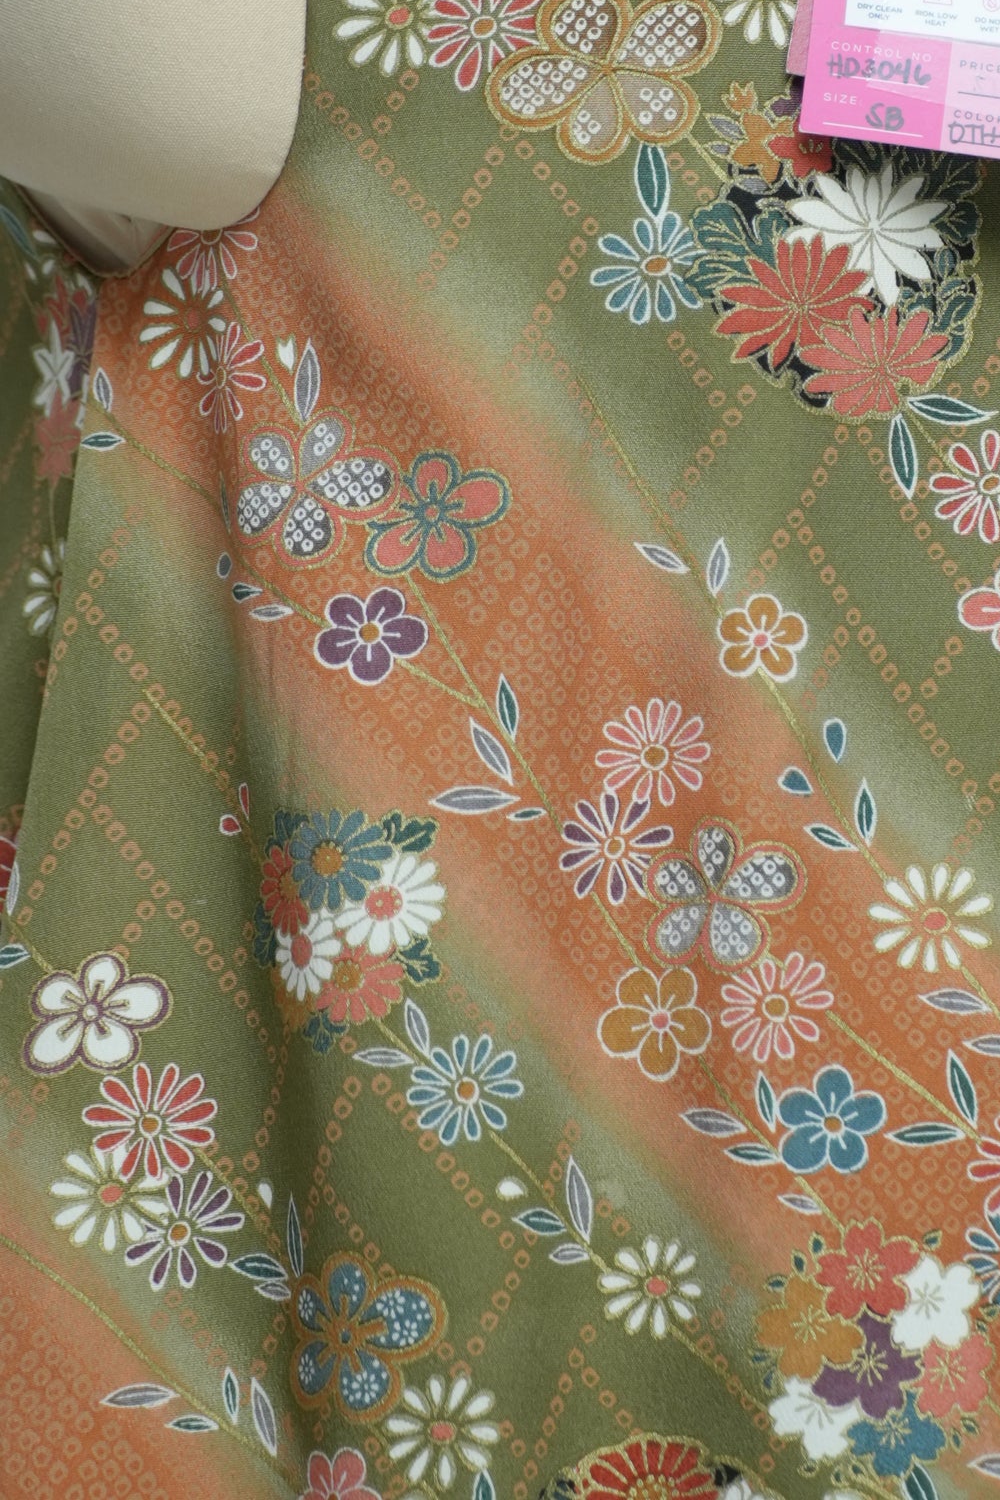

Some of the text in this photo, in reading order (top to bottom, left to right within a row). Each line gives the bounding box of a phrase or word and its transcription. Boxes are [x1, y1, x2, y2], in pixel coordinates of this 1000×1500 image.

[857, 2, 902, 14] DRY CLEAN
[868, 12, 890, 21] ONLY
[831, 41, 903, 59] CONTROL
